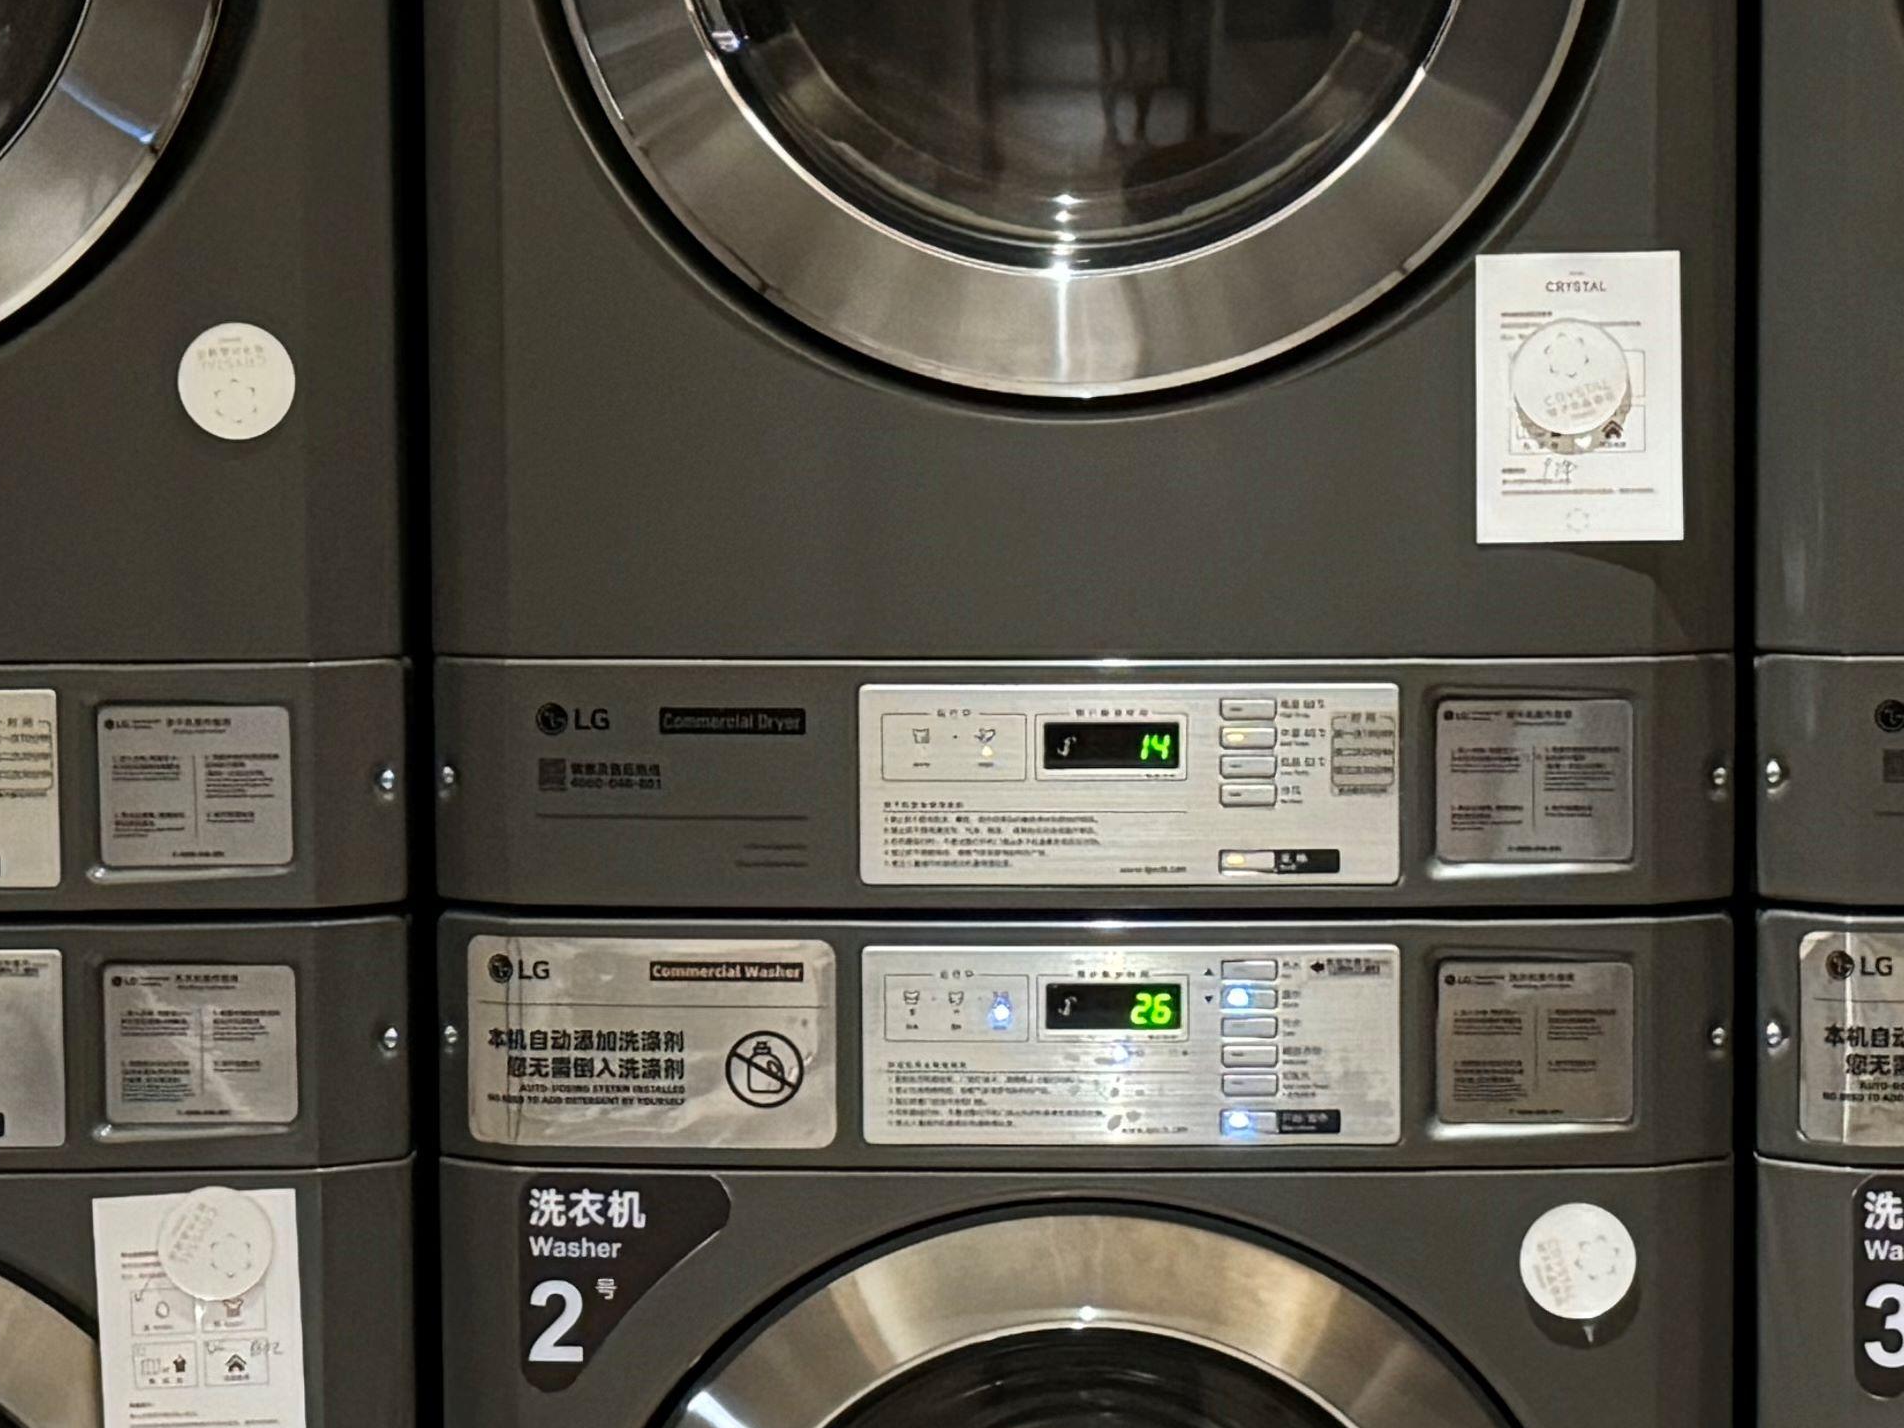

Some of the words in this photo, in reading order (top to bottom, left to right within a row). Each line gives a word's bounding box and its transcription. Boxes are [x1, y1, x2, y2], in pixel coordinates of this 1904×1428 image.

[1545, 280, 1607, 293] CRYSTAL
[574, 708, 610, 730] LG
[663, 712, 753, 730] Commercial
[757, 712, 801, 732] Dryer
[1141, 735, 1170, 759] 14
[519, 961, 550, 980] LG
[652, 963, 741, 980] Commercial
[744, 963, 802, 981] Washer
[1860, 956, 1893, 977] LG
[1130, 992, 1173, 1026] 26
[488, 1029, 684, 1052] 本机自动添加洗涤剂
[529, 1188, 646, 1228] 洗衣机
[529, 1236, 622, 1258] Washer
[528, 1279, 583, 1362] 2
[595, 1278, 617, 1300] 号
